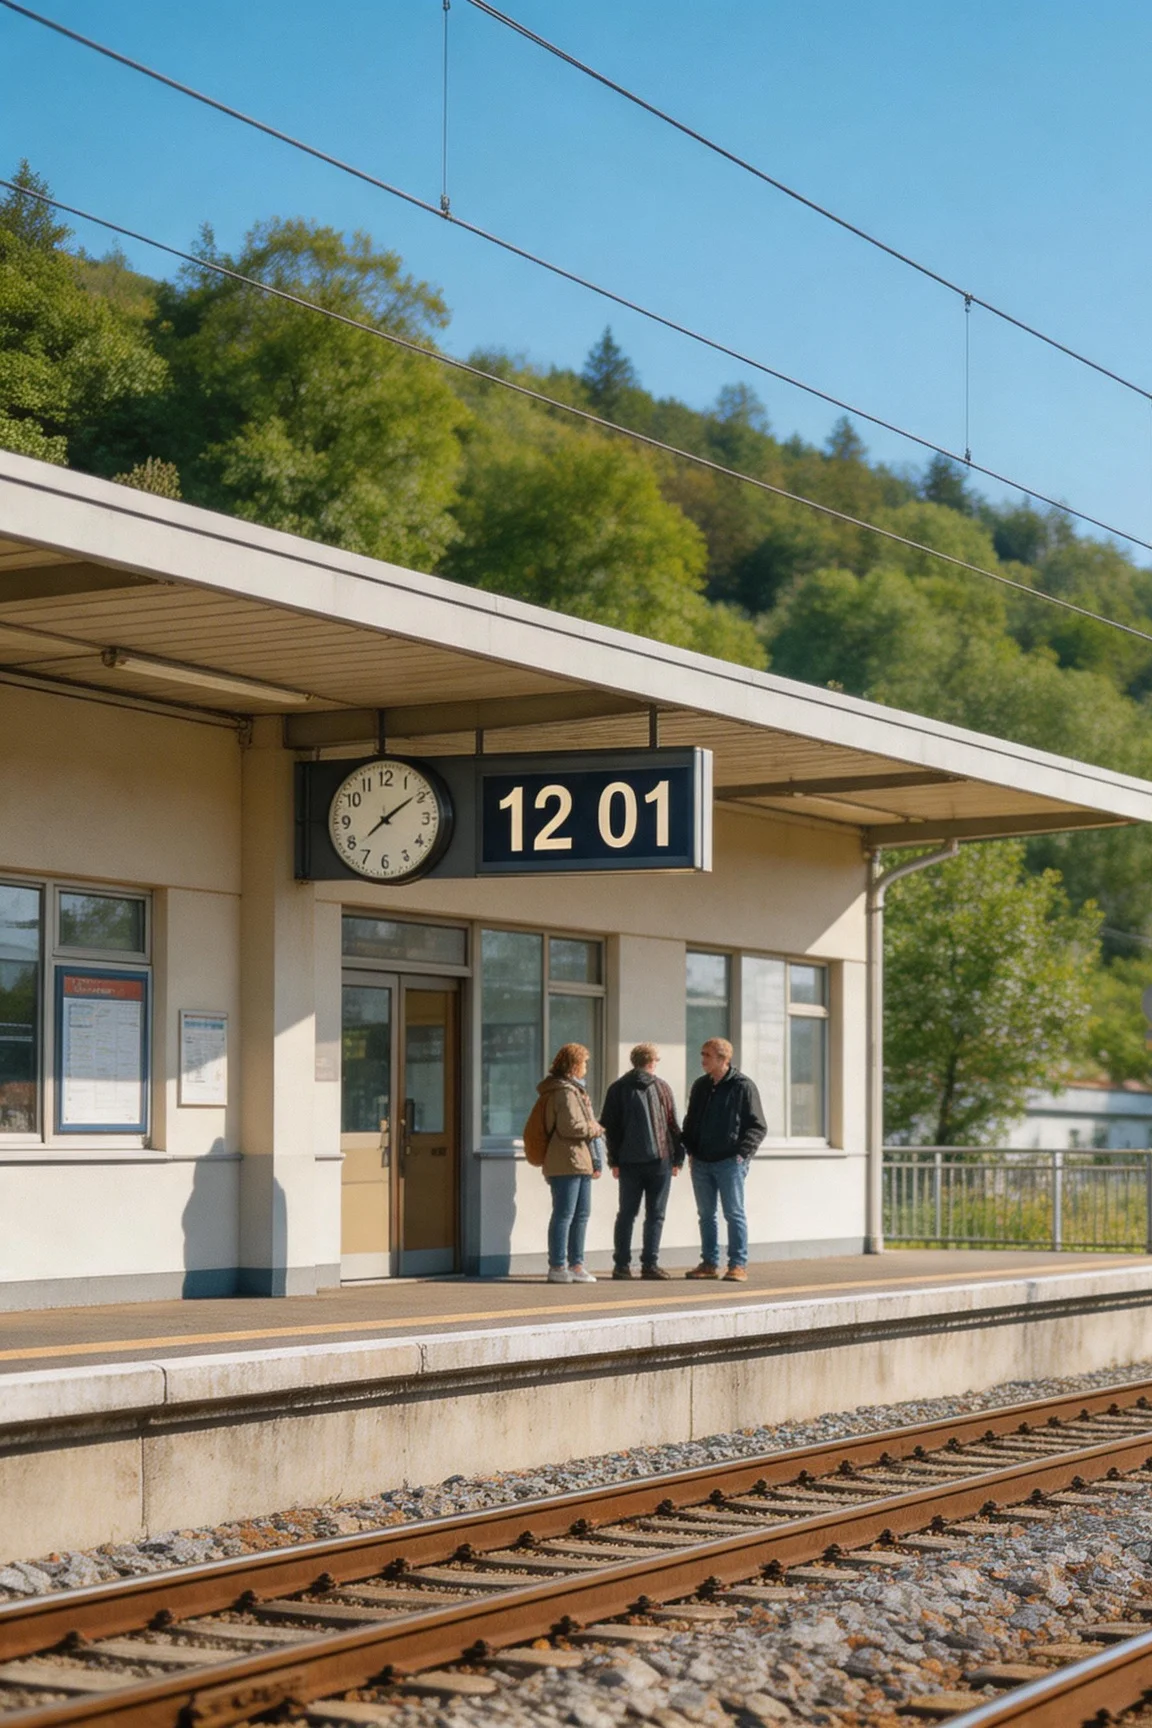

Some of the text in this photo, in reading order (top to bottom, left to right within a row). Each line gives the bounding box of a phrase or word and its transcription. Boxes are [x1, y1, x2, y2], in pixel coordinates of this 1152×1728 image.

[362, 777, 372, 792] 11
[379, 770, 394, 787] 12
[347, 792, 362, 807] 10
[341, 815, 351, 829] 9
[499, 780, 669, 852] 12 01
[347, 835, 357, 850] 8
[361, 849, 371, 865] 7
[381, 854, 389, 869] 6
